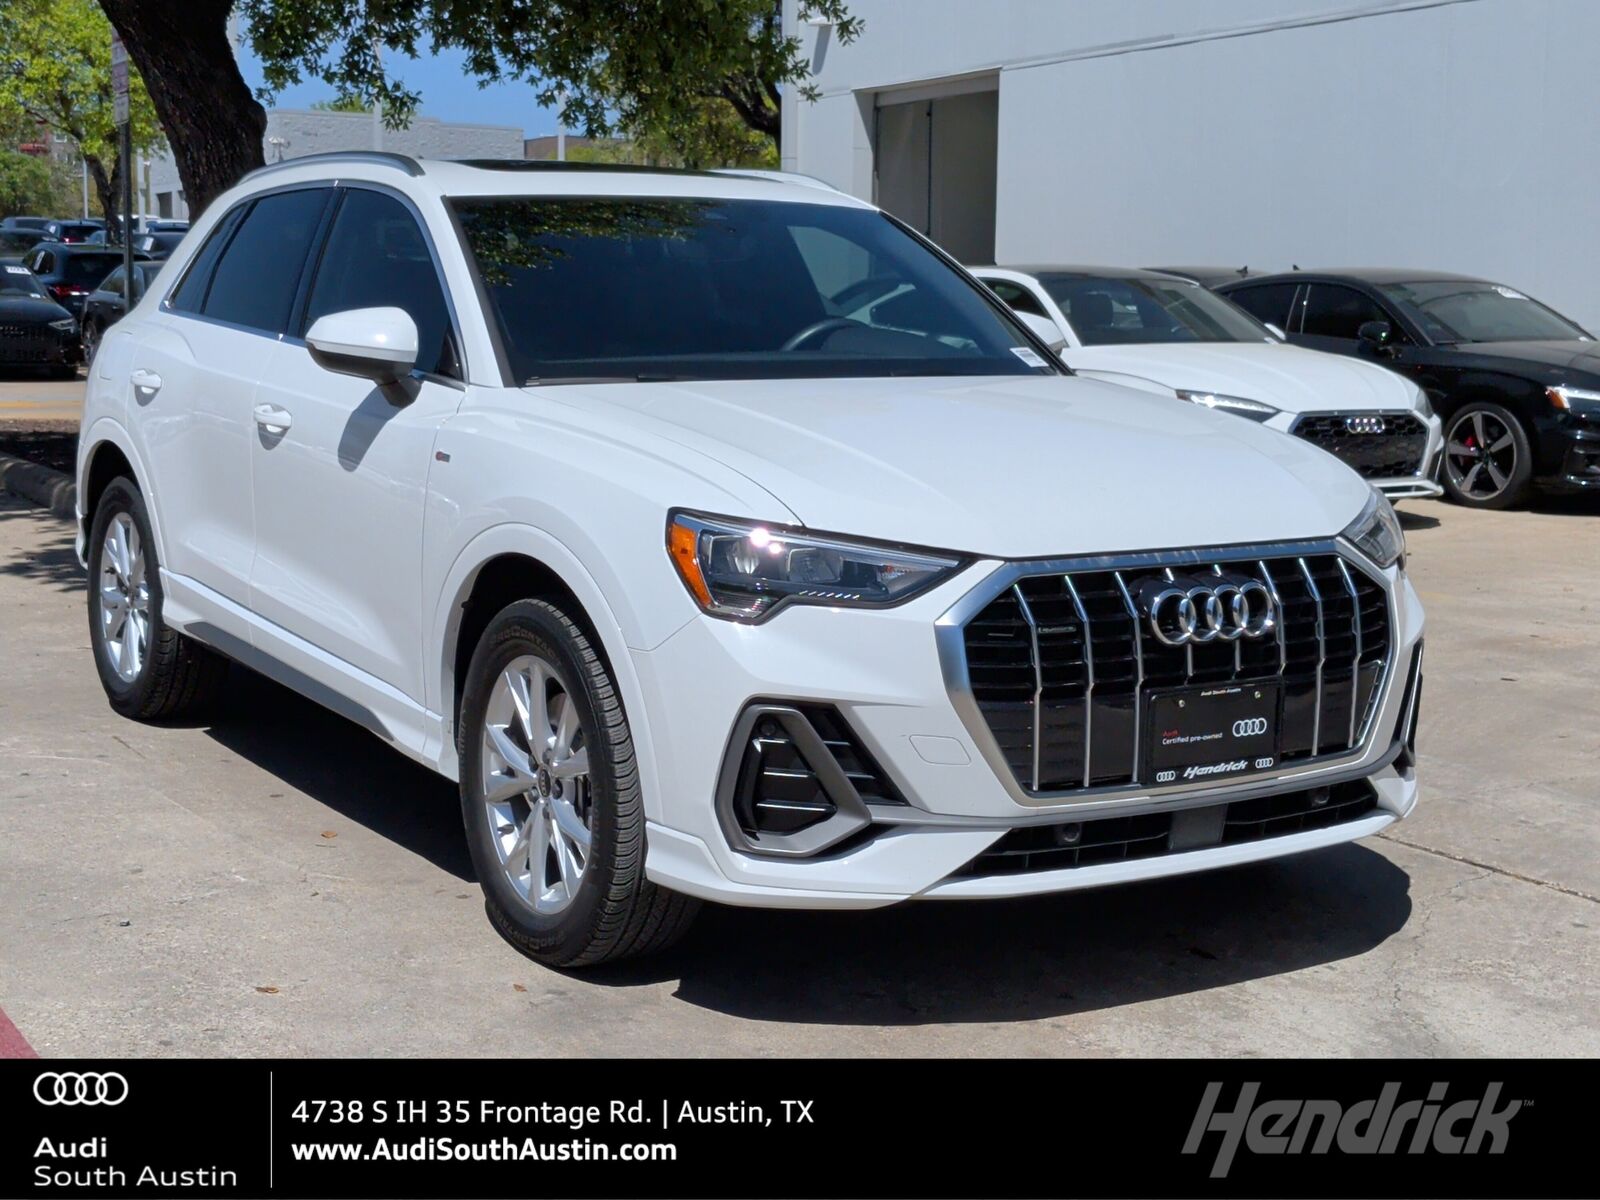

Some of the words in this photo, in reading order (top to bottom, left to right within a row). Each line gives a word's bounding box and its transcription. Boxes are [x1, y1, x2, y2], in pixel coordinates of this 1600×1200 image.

[1162, 729, 1179, 737] Audi
[1162, 736, 1190, 745] Certified
[1190, 732, 1223, 743] pre-owned
[1183, 760, 1249, 779] Hendrick
